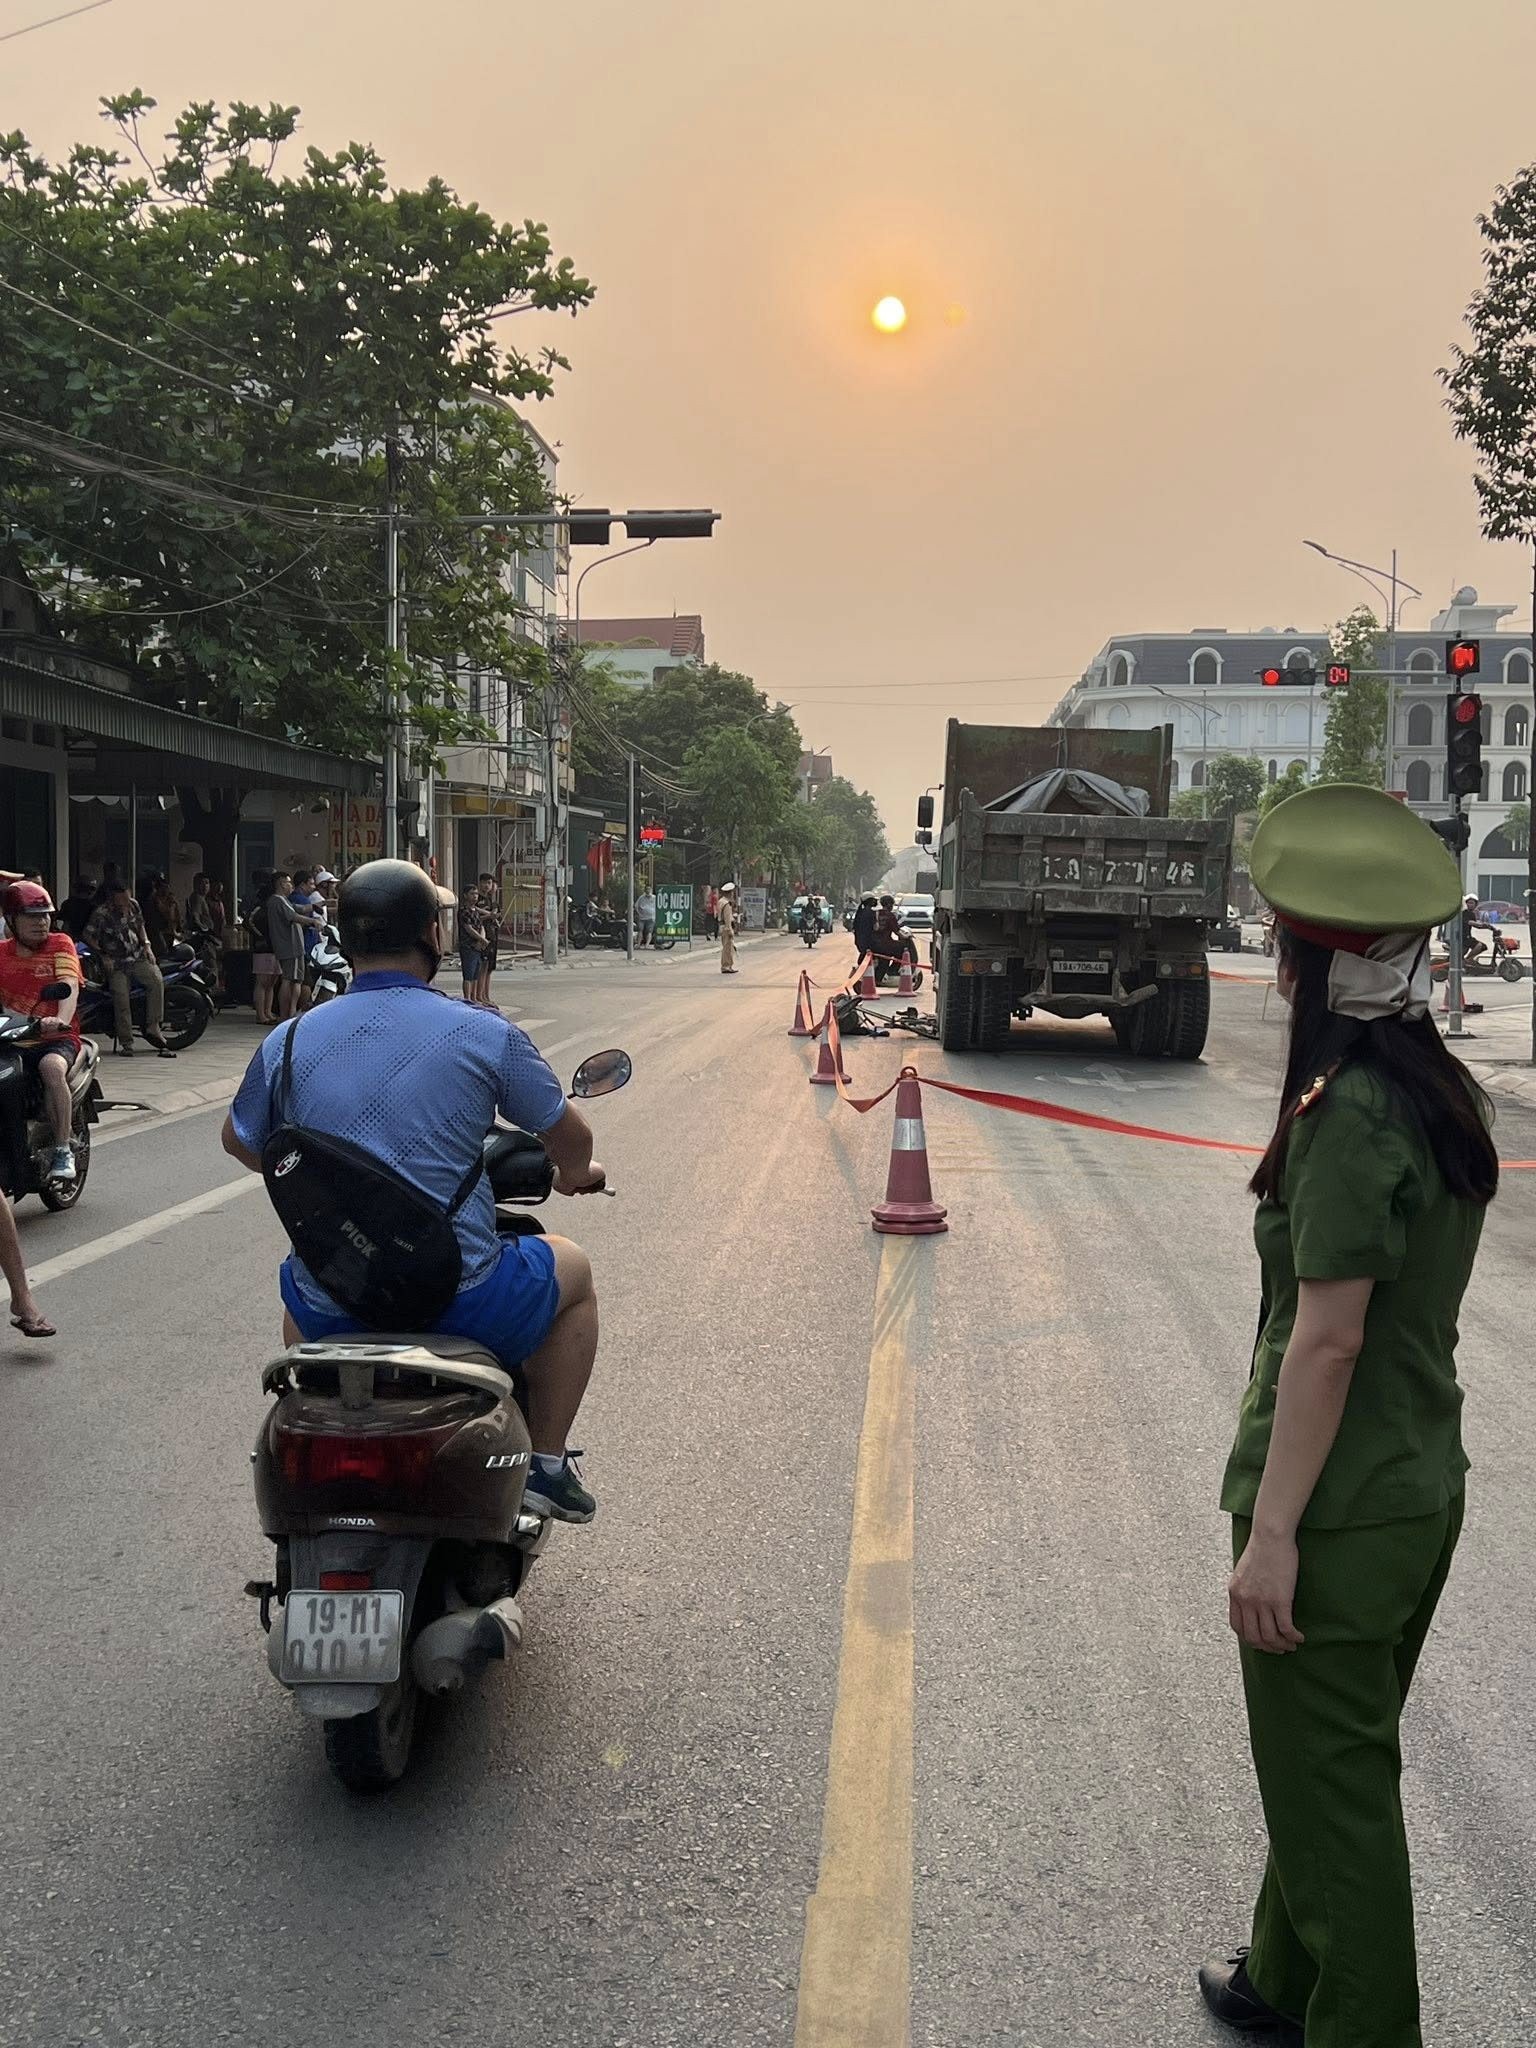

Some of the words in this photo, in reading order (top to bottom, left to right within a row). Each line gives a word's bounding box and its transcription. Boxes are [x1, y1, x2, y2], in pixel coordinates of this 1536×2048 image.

[1329, 666, 1347, 684] 04
[664, 910, 683, 926] 19
[485, 1452, 529, 1468] LEAD
[328, 1517, 376, 1526] HONDA
[306, 1597, 382, 1635] 19-M1
